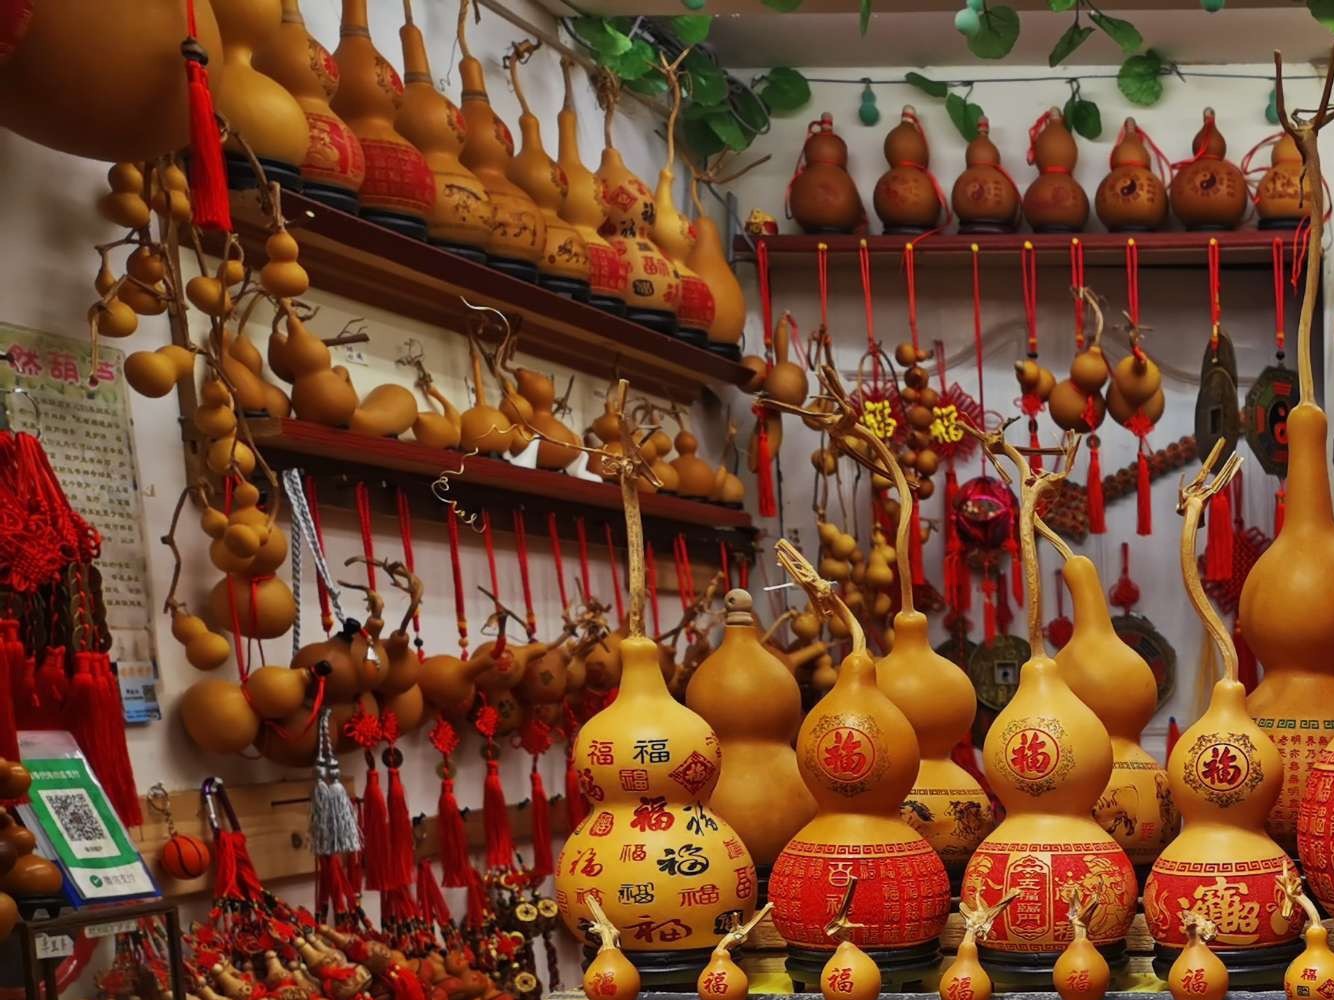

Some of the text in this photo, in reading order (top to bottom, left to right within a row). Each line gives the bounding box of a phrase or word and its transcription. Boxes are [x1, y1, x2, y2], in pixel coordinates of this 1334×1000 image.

[588, 740, 615, 765] 福
[633, 738, 671, 764] 福
[824, 730, 866, 775] 福
[1011, 731, 1051, 775] 福
[1203, 746, 1242, 786] 福
[620, 768, 650, 792] 福
[630, 796, 675, 833] 福
[569, 848, 604, 877] 福
[620, 844, 647, 863] 福
[657, 843, 710, 876] 福
[618, 882, 655, 905] 福
[678, 884, 720, 907] 福
[622, 915, 693, 943] 福
[588, 971, 618, 998] 福
[703, 971, 729, 996] 福
[826, 967, 855, 995] 福
[1066, 969, 1090, 992] 福
[1181, 968, 1209, 996] 福
[1301, 968, 1318, 981] 福
